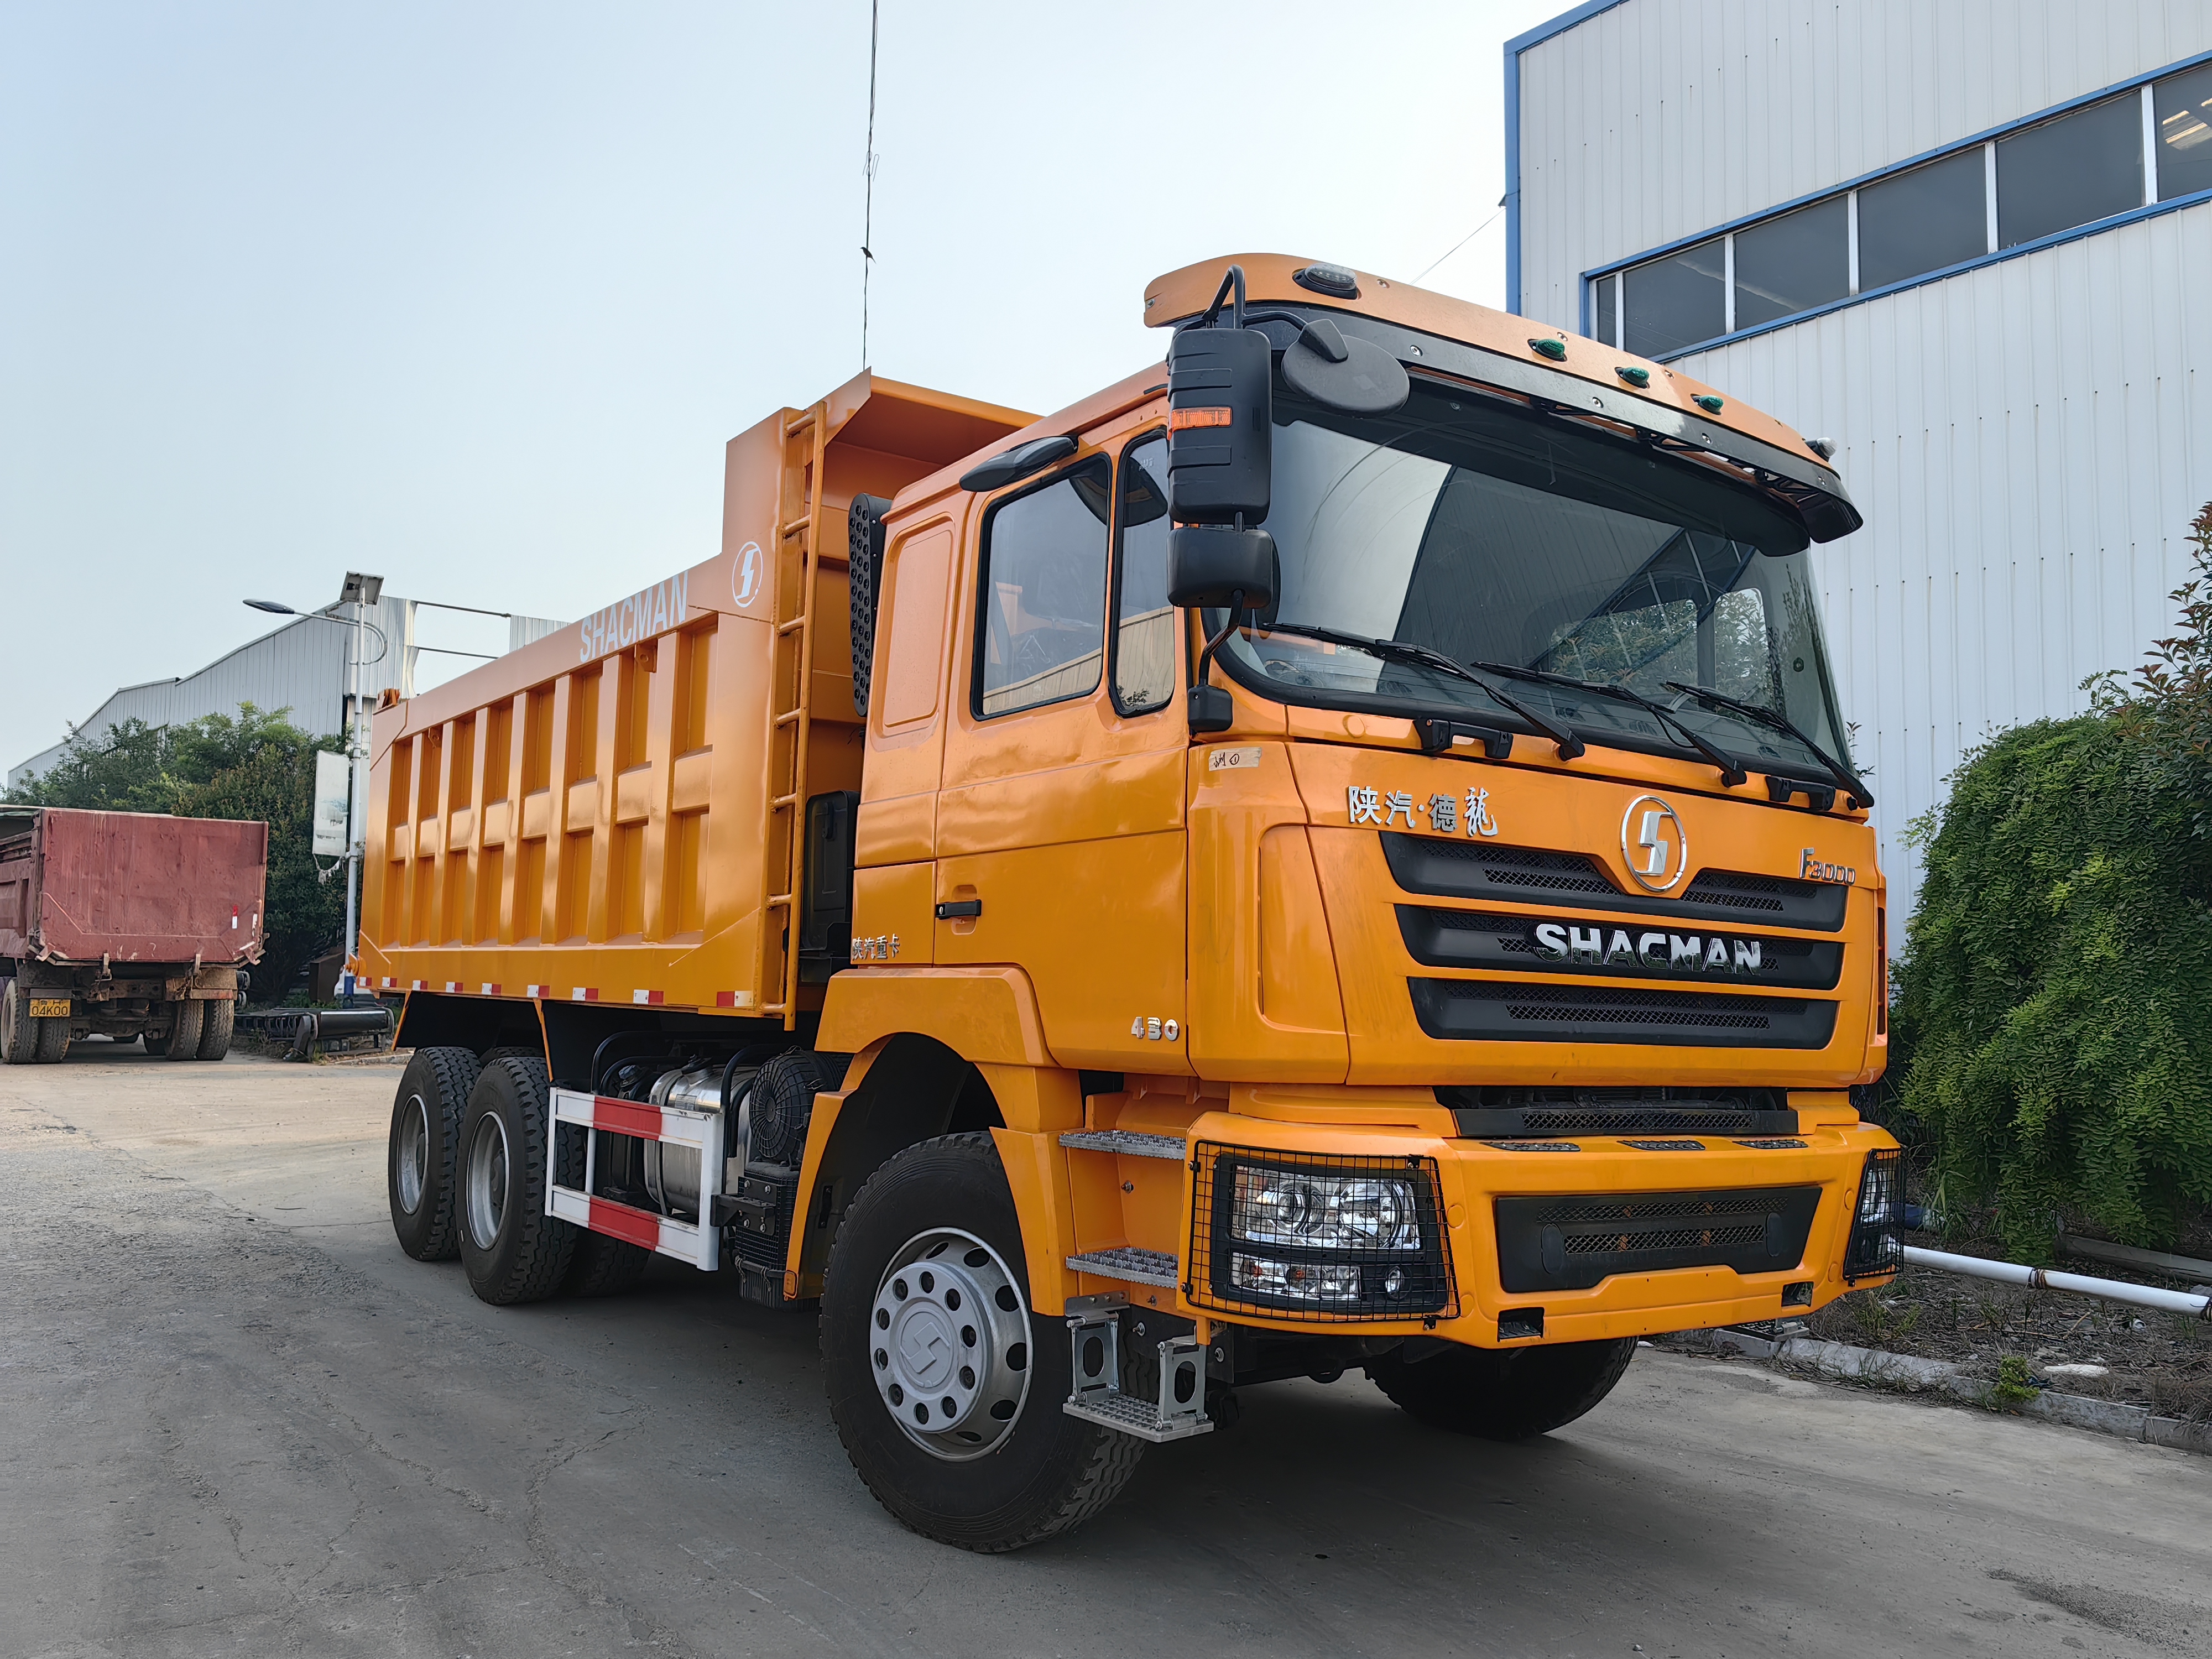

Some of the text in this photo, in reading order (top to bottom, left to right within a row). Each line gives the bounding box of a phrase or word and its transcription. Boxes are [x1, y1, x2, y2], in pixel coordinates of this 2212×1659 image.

[580, 570, 688, 662] SHACMAN
[1799, 847, 1856, 885] F3000
[852, 933, 900, 961] 陕汽重卡
[1533, 924, 1762, 976] SHACMAN
[1131, 1016, 1179, 1041] 430
